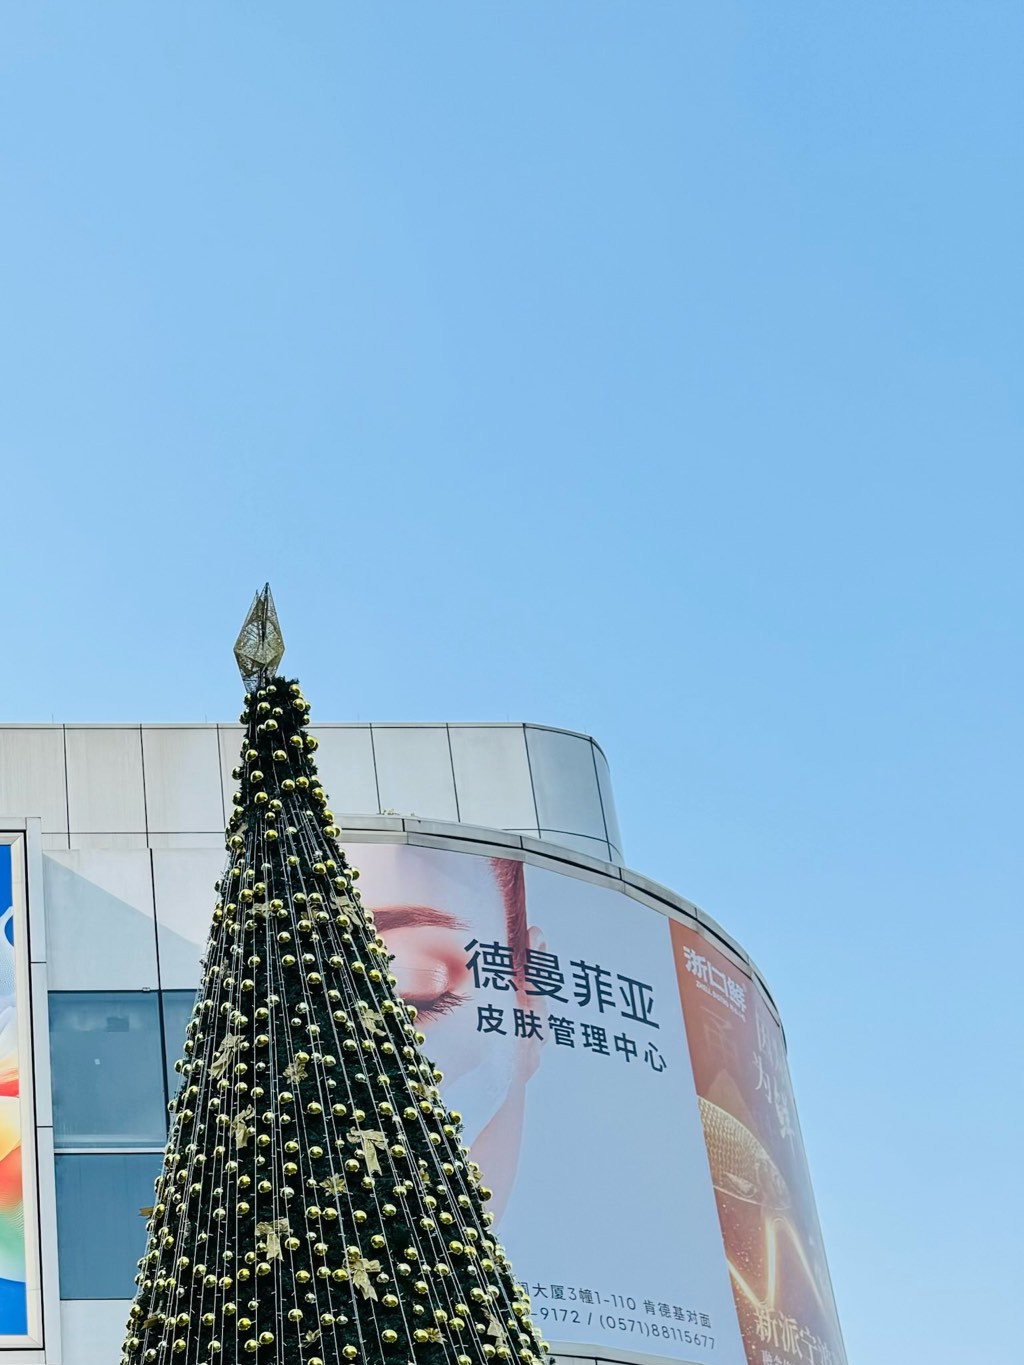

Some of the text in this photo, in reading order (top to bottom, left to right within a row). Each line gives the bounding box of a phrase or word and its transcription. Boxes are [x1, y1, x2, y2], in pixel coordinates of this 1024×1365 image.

[464, 938, 660, 1029] 德曼菲亚
[476, 1003, 668, 1073] 皮肤管理中心
[599, 1314, 716, 1350] (0571)88115677
[643, 1299, 712, 1329] 肯德基对面
